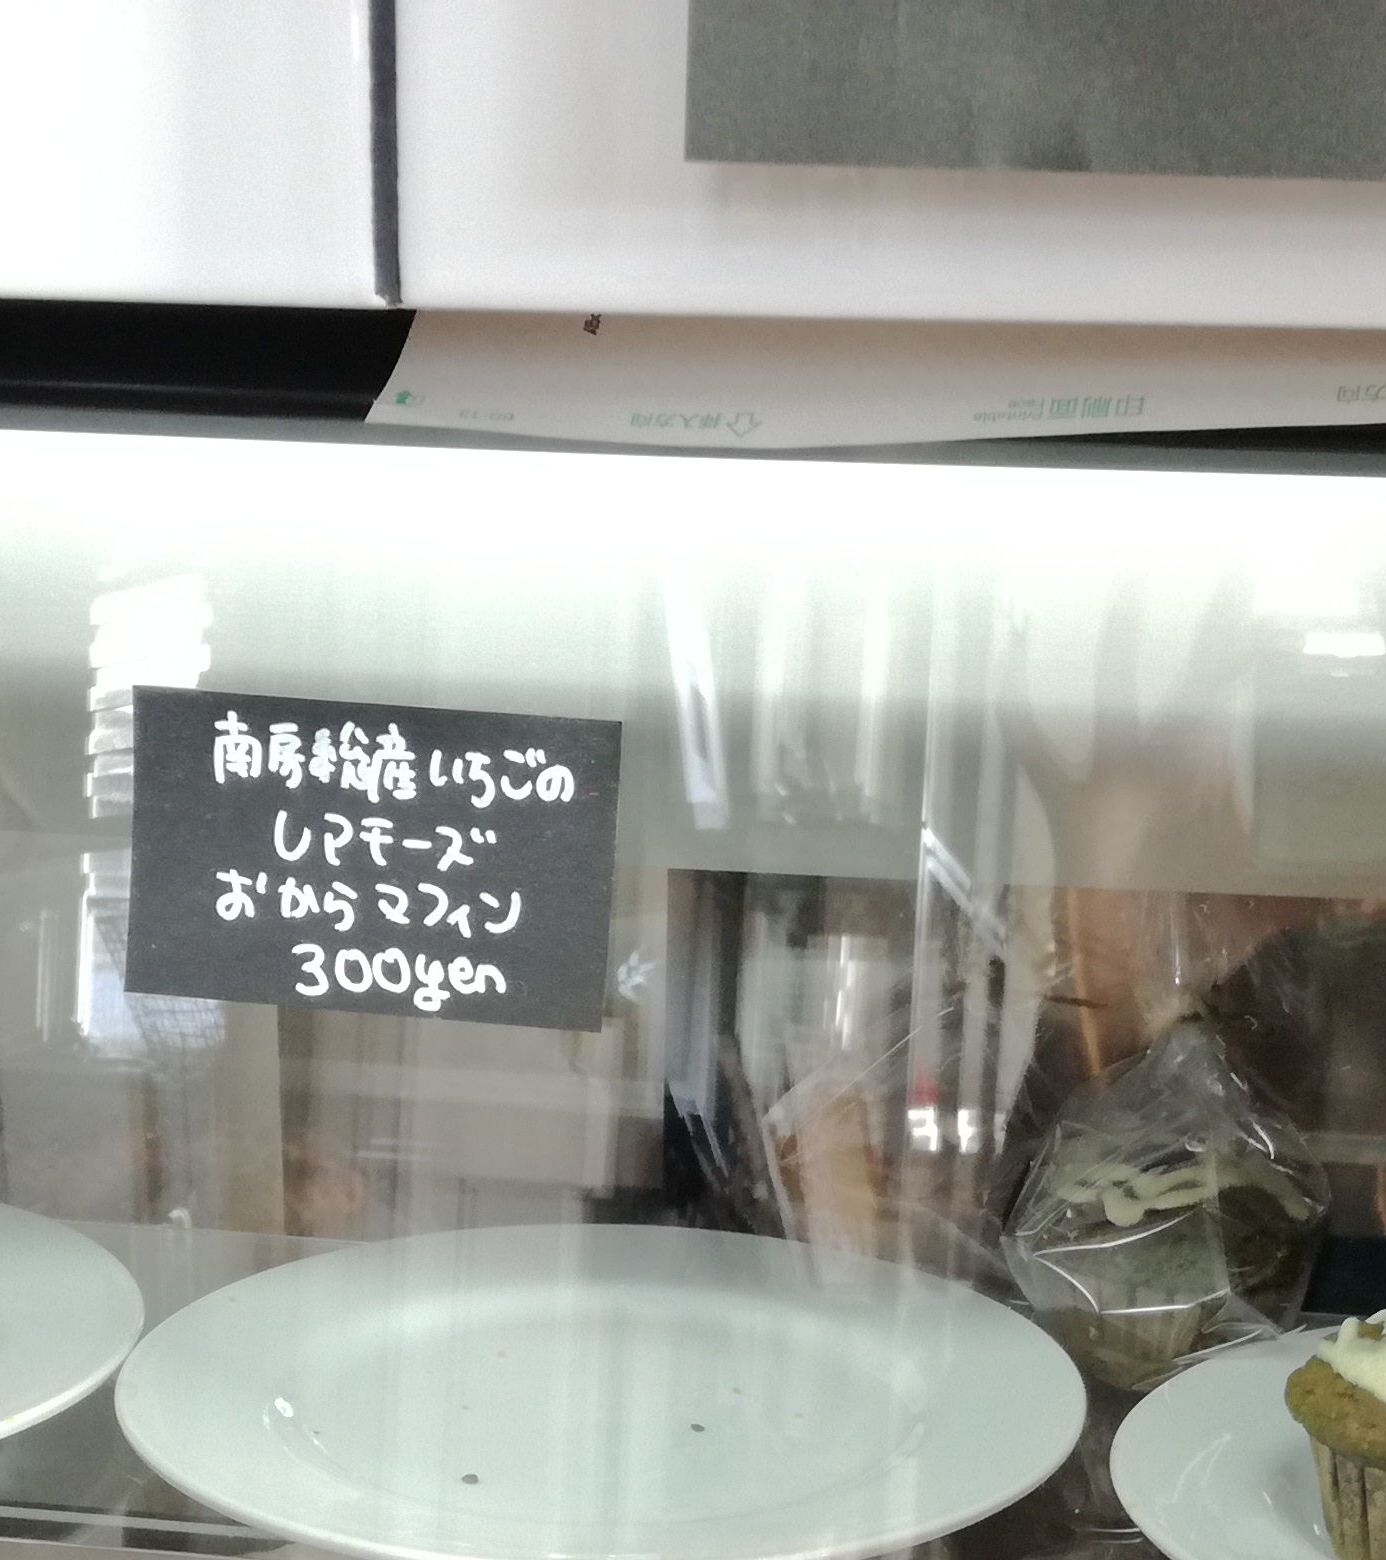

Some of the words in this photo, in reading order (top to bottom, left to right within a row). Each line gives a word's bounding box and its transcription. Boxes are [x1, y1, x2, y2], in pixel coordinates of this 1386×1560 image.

[214, 711, 574, 808] 南房総産いちごの
[215, 868, 522, 938] おからマフィン
[291, 943, 507, 1012] 300yen
